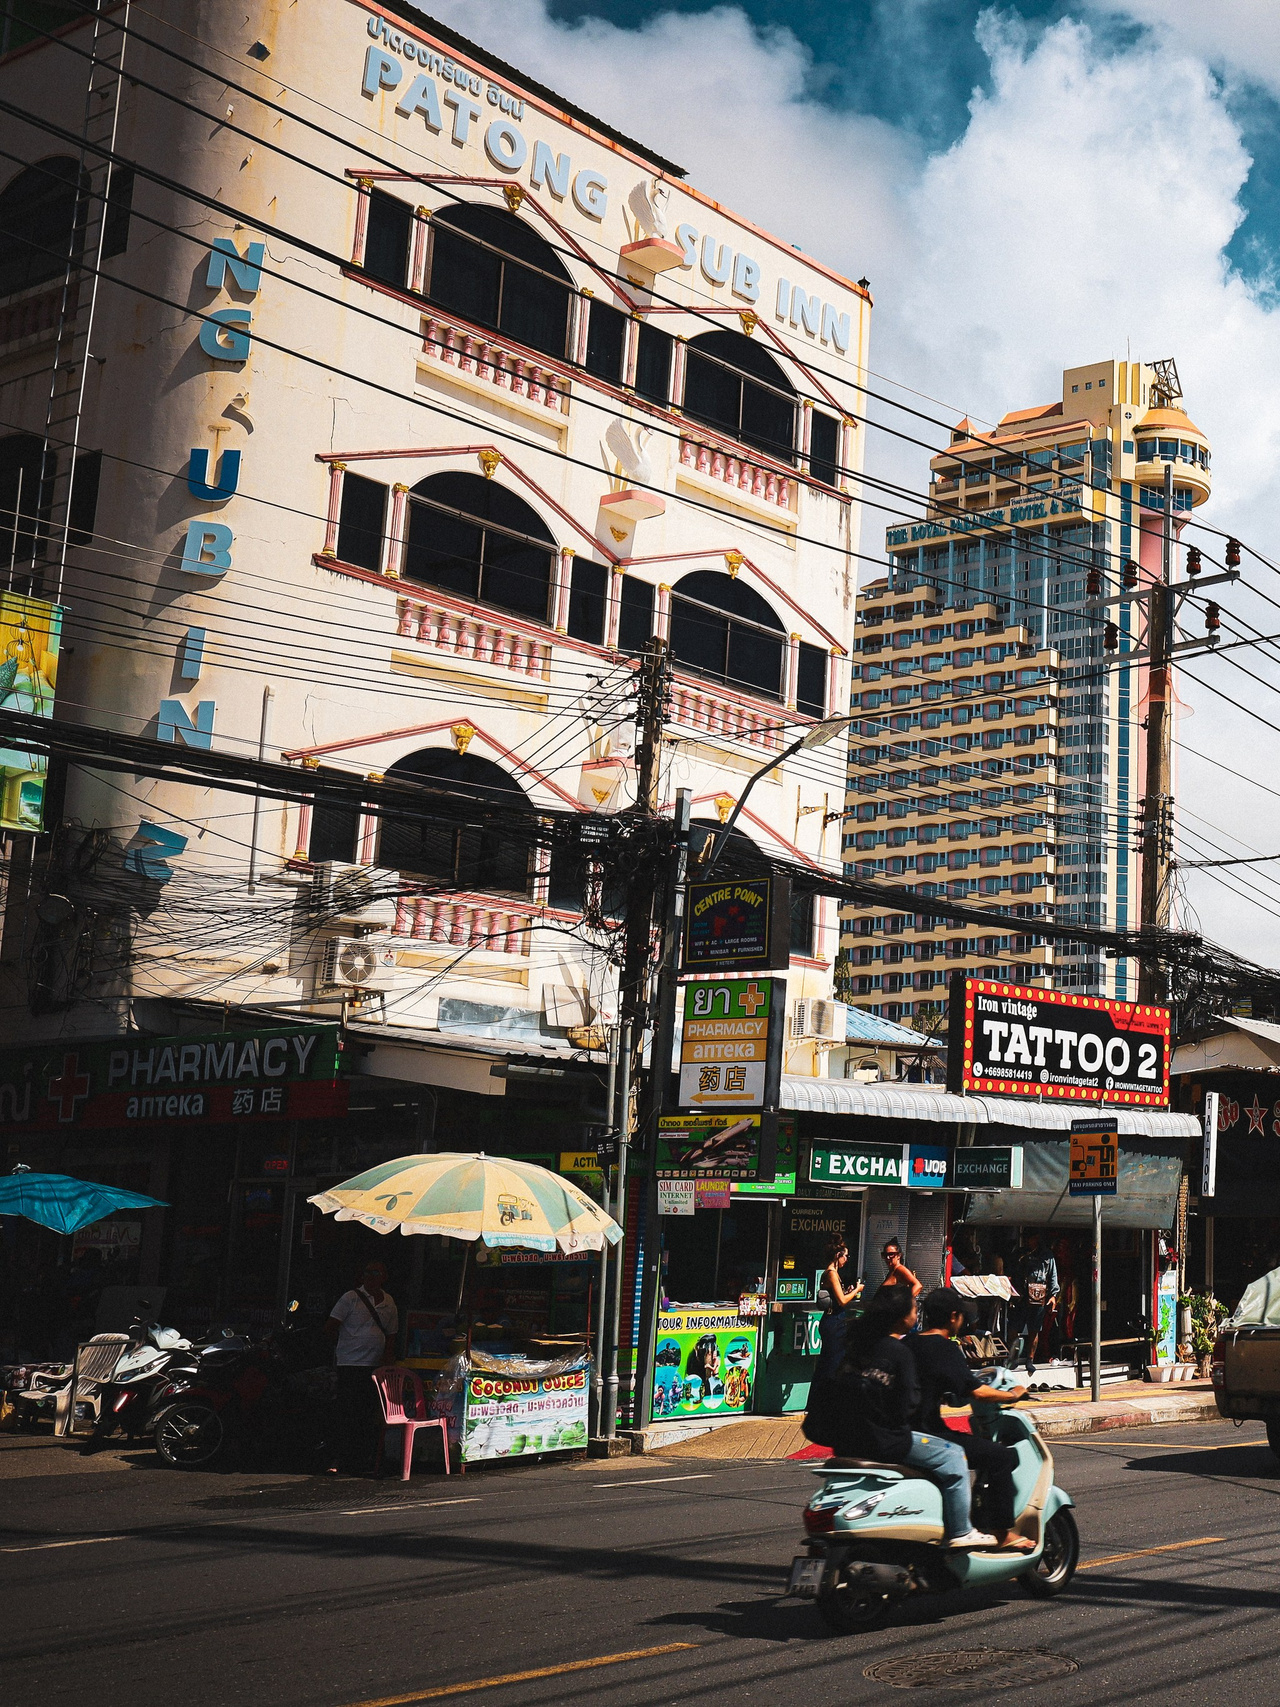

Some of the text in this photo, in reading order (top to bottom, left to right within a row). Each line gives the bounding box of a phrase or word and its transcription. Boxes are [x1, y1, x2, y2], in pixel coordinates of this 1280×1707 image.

[361, 45, 608, 222] PATONG
[675, 223, 850, 355] SUB INN
[886, 528, 908, 546] THE
[911, 522, 947, 541] ROYAL
[1010, 502, 1047, 523] HOTEL
[694, 887, 764, 917] CENTRE POINT
[693, 987, 731, 1016] ยา
[977, 995, 1038, 1021] Iron vintage
[688, 1021, 764, 1037] PHARMACY
[693, 1043, 755, 1059] аптека
[983, 1019, 1157, 1079] TATTOO 2
[107, 1035, 317, 1087] PHARMACY
[699, 1065, 746, 1091] 药店
[984, 1068, 1032, 1081] +66985814419
[1049, 1072, 1099, 1087] ironvintagetat2
[1114, 1081, 1163, 1093] IRONVINTAGETATTOO
[126, 1093, 204, 1119] аптека
[232, 1086, 283, 1115] 药店
[264, 1160, 289, 1170] OPEN
[924, 1159, 947, 1174] UOB
[957, 1163, 1008, 1174] EXCHANGE
[659, 1181, 693, 1192] SIM CARD
[695, 1180, 729, 1191] LAUNDRY
[791, 1208, 824, 1216] CURRENCY
[790, 1219, 847, 1232] EXCHANGE
[779, 1283, 804, 1294] OPEN
[658, 1316, 683, 1330] TOUR
[794, 1320, 822, 1350] EXC
[471, 1377, 539, 1398] COCONUT
